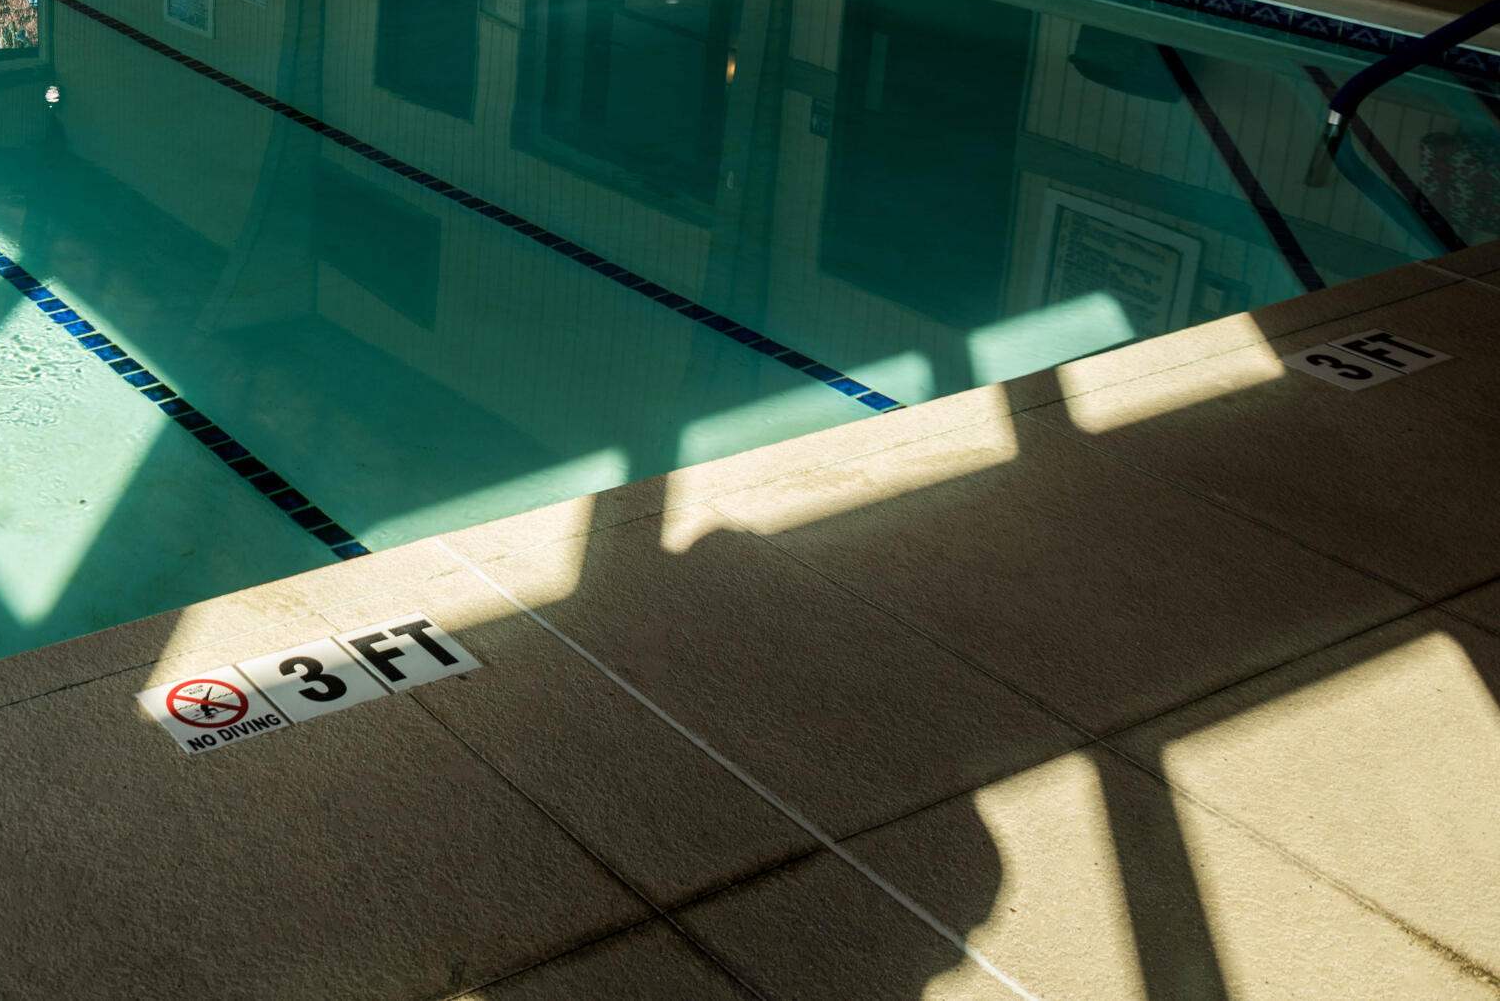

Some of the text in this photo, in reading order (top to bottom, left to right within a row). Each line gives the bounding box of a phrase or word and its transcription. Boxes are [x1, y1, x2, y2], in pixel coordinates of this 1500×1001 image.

[1305, 332, 1436, 381] 3 FT
[278, 618, 460, 702] 3 FT
[187, 712, 282, 753] NO DIVING
